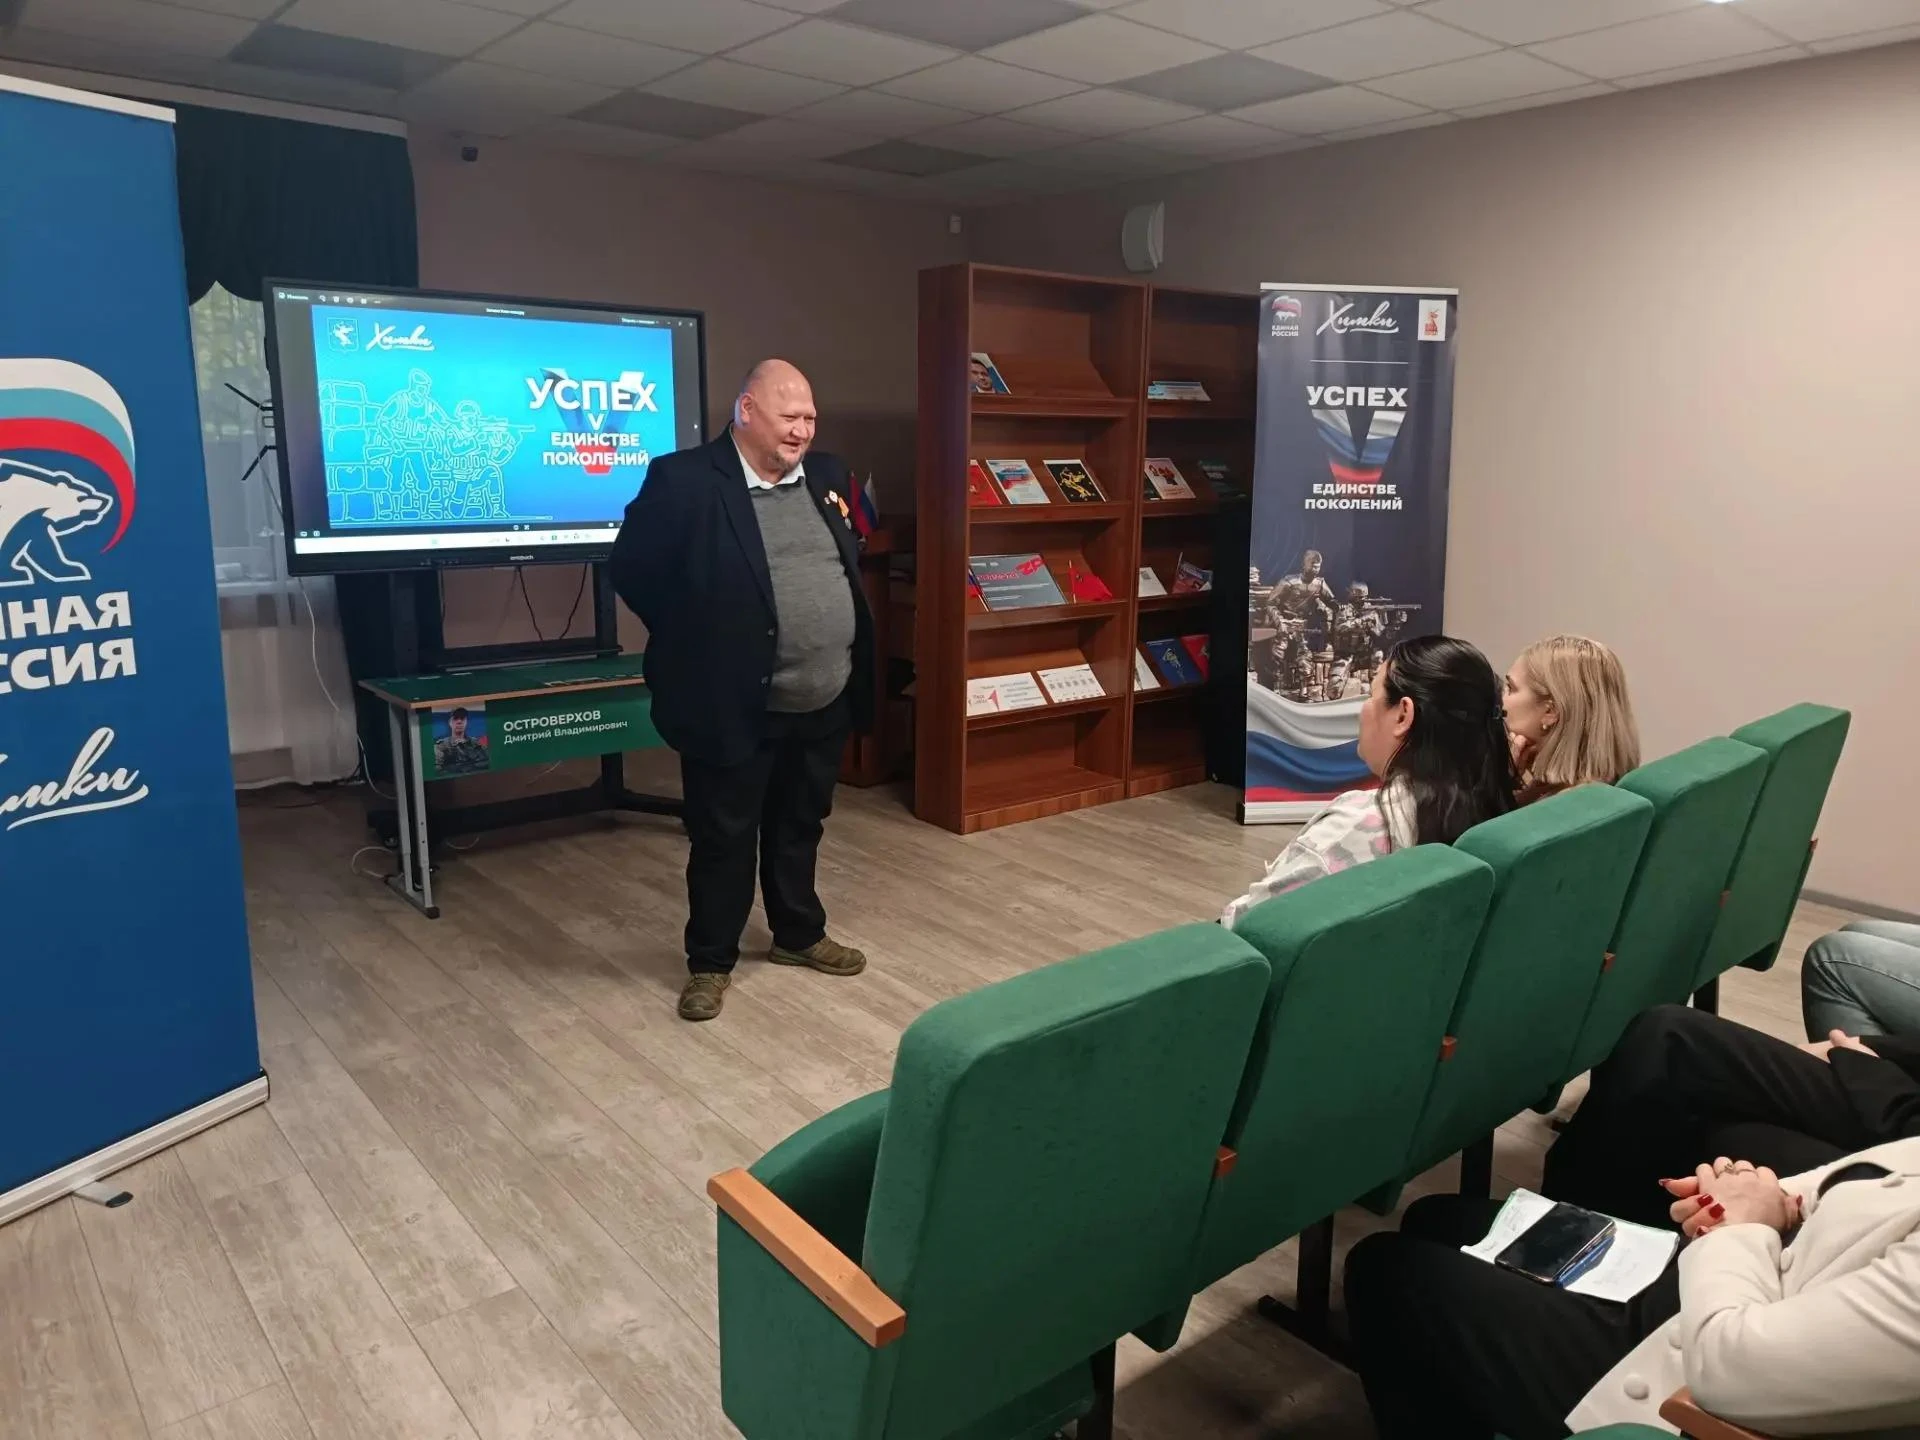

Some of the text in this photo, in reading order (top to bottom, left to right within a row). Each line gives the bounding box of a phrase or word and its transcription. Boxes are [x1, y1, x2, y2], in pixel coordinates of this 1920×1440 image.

[525, 377, 658, 412] УСПЕХ
[1306, 385, 1409, 407] УСПЕХ
[550, 431, 640, 449] ЕДИНСТВЕ
[542, 449, 650, 466] ПОКОЛЕНИЙ
[1312, 483, 1397, 496] ЕДИНСТВЕ
[1304, 497, 1403, 511] ПОКОЛЕНИЙ
[0, 591, 132, 641] НАЯ
[503, 710, 601, 732] ОСТРОВЕРХОВ
[503, 721, 628, 745] Дмитрий Владимирович
